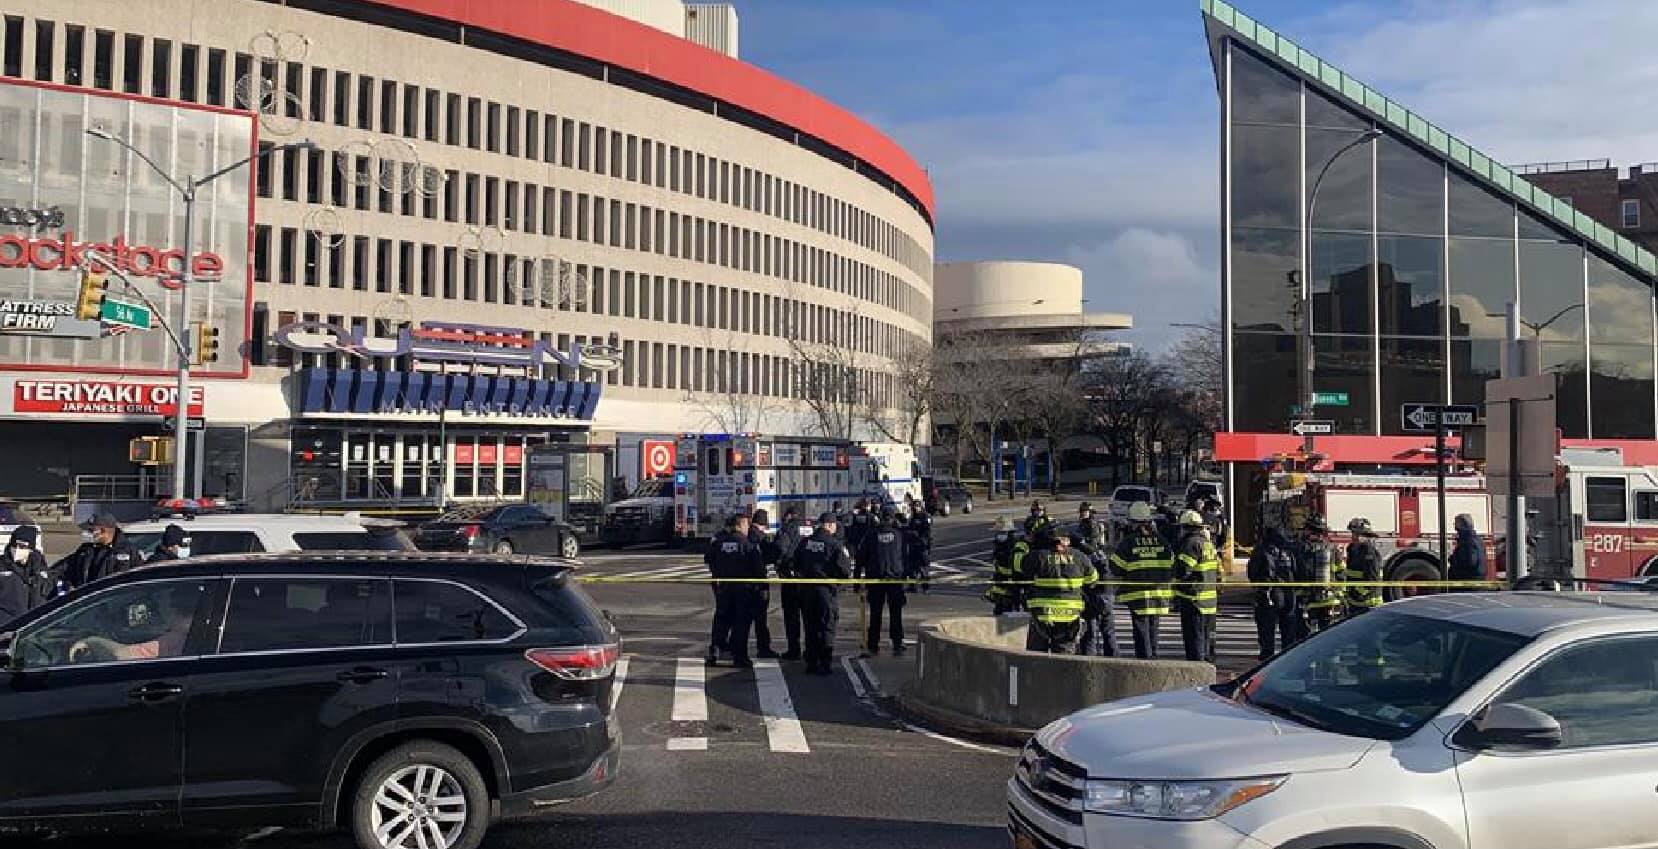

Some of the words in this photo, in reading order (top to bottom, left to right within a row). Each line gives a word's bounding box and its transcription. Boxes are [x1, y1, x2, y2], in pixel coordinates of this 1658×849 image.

[0, 231, 223, 290] ackstage
[0, 300, 76, 314] ATTRESS
[3, 313, 56, 329] FIRM
[17, 381, 142, 404] TERIYAKI
[61, 401, 126, 413] JAPANESE
[127, 404, 159, 414] GRILL
[380, 399, 444, 416] MAIN
[463, 400, 578, 418] ENTRANCE
[1415, 411, 1437, 424] ONE
[1445, 412, 1470, 424] WAY
[1593, 534, 1623, 553] 287
